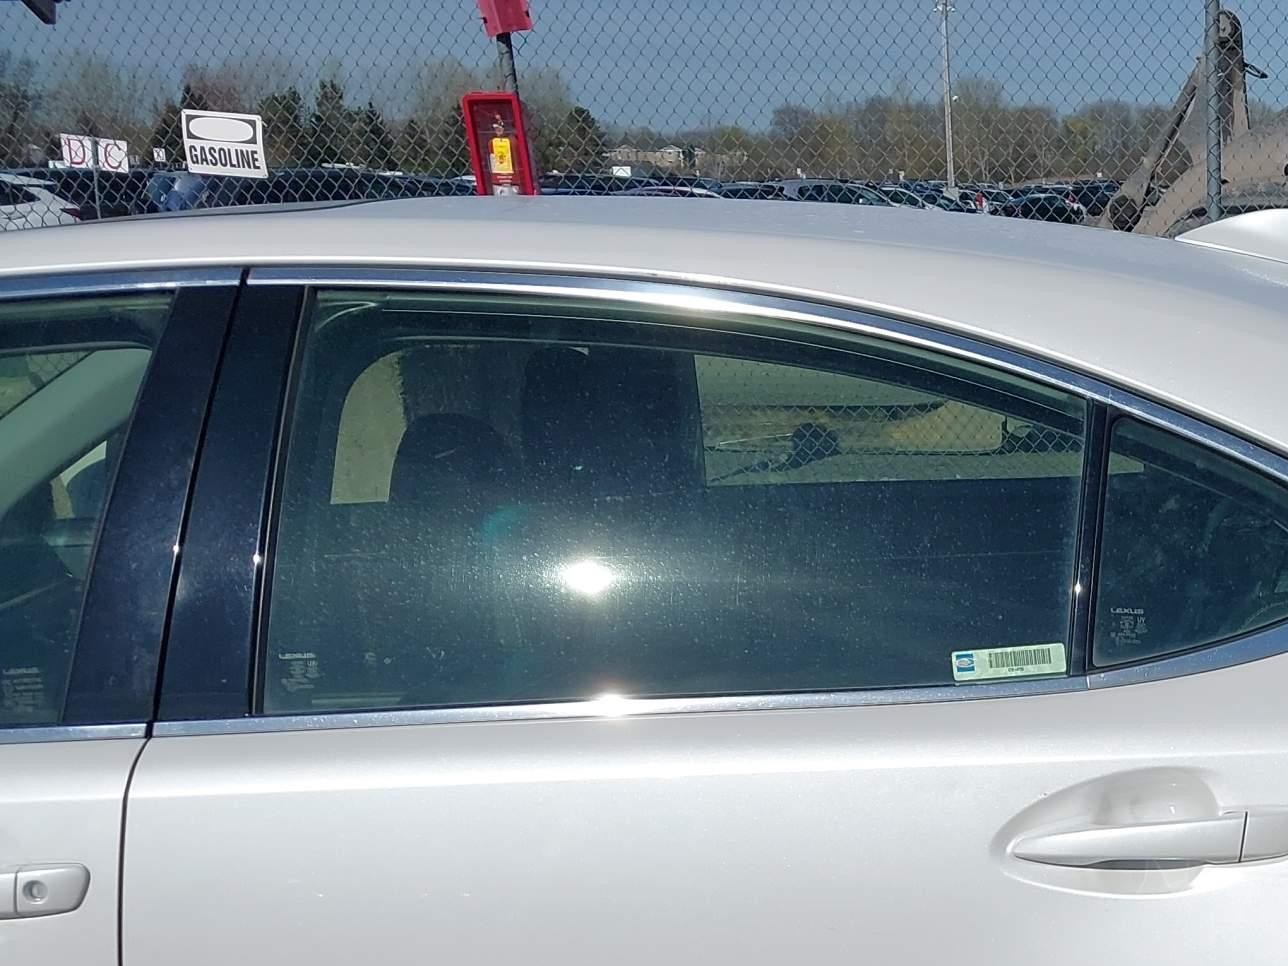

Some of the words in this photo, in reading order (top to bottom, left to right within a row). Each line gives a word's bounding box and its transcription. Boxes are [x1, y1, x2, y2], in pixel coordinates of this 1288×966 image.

[67, 138, 86, 165] D
[104, 143, 123, 170] C
[188, 145, 261, 170] GASOLINE
